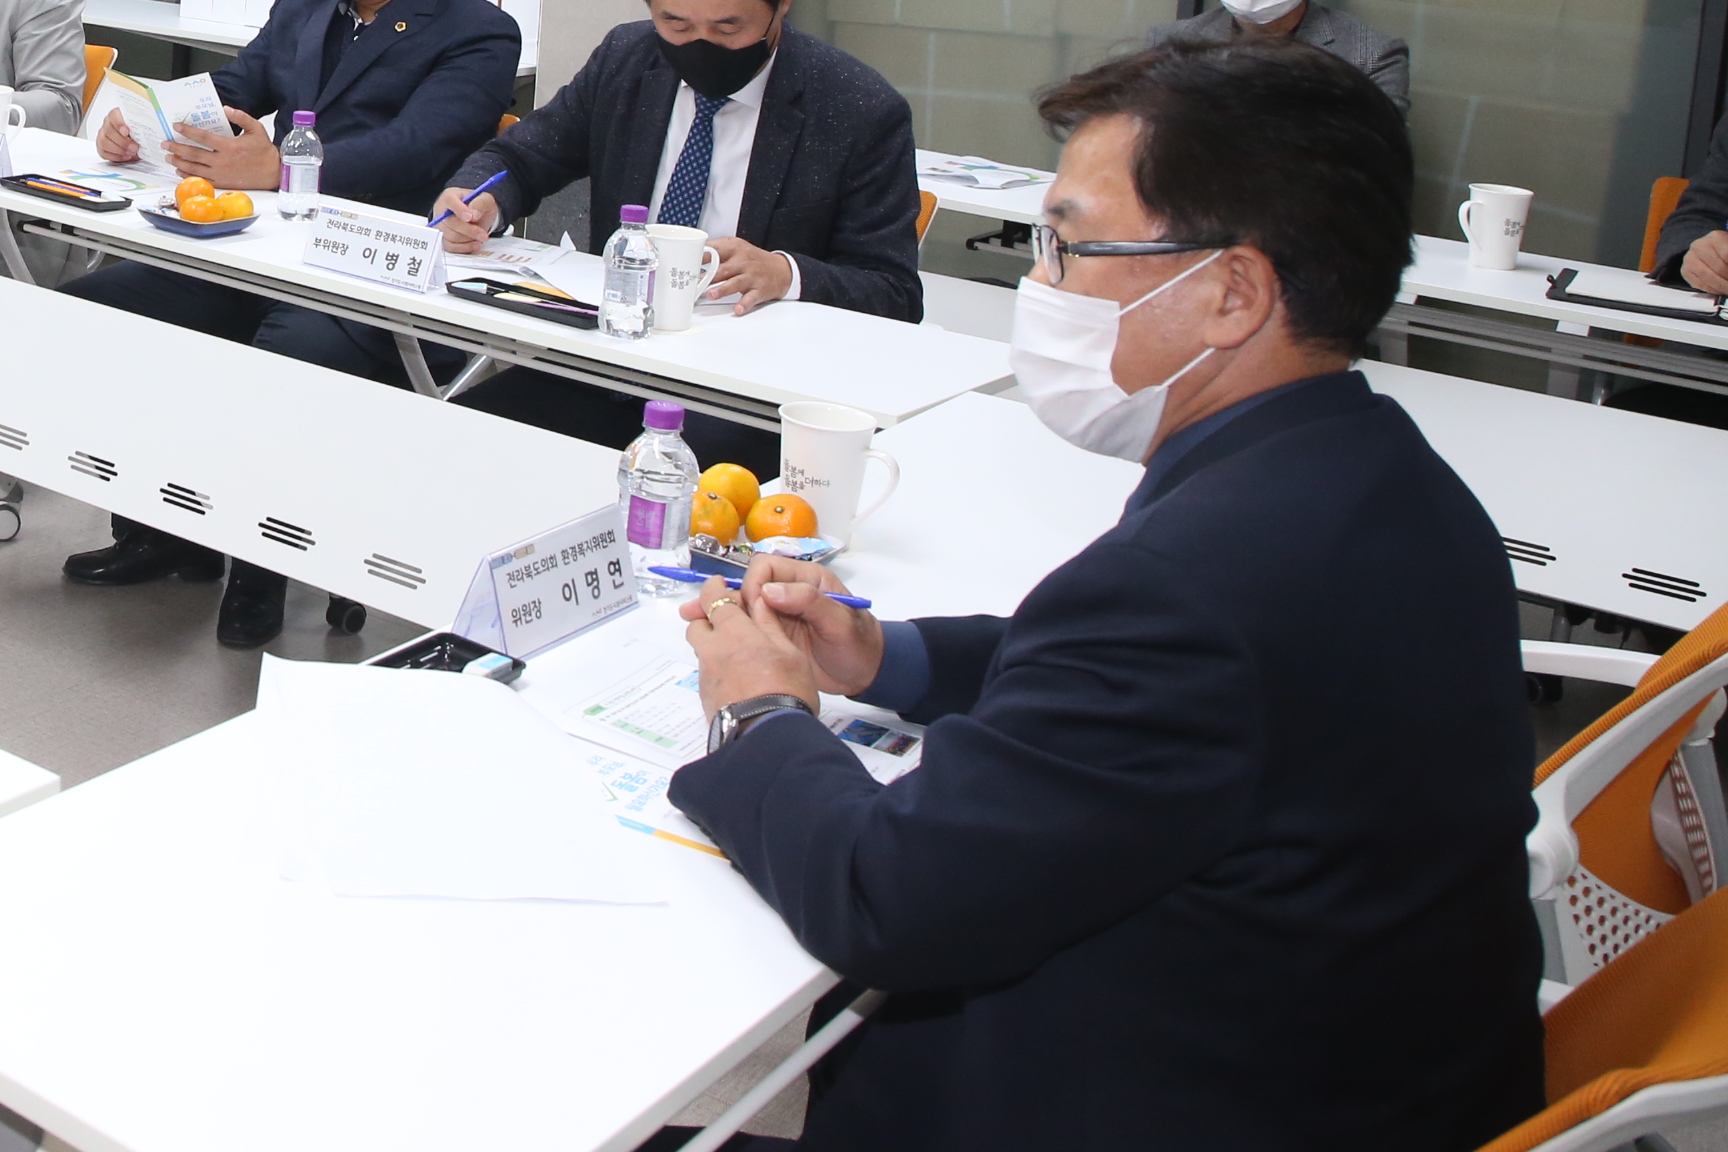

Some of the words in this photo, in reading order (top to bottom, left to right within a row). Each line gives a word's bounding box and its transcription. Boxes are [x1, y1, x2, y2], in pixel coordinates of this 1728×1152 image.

[312, 237, 349, 256] 부위원장
[326, 218, 371, 237] 전라북도의회
[374, 230, 428, 252] 환경복지위원회
[506, 553, 558, 589] 전라북도의회
[559, 528, 617, 567] 환경복지위원회
[511, 598, 543, 628] 위원장
